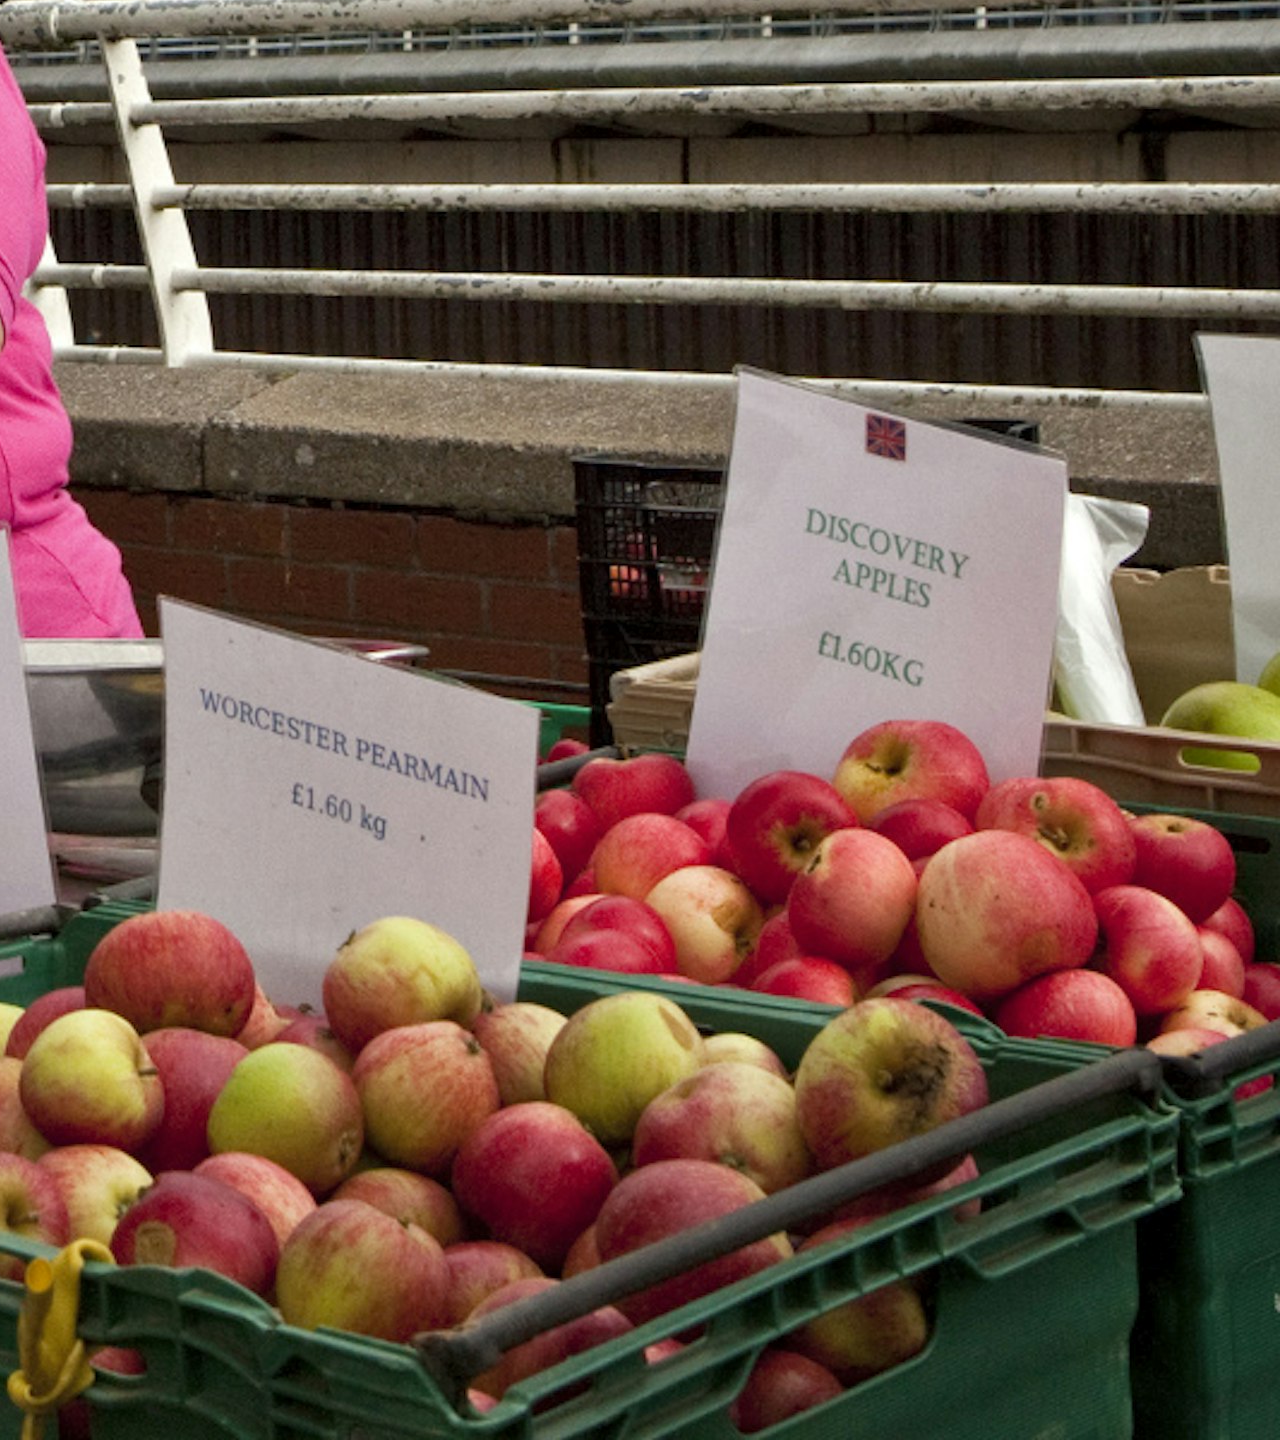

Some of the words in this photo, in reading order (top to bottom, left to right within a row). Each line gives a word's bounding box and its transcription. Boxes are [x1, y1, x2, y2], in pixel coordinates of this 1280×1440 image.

[805, 507, 970, 580] DISCOVERY
[832, 558, 933, 609] APPLES
[818, 630, 926, 688] £1.60KG
[199, 687, 349, 757] WORCESTER
[355, 736, 490, 802] PEARMAIN
[291, 781, 353, 824] £1.60
[359, 804, 388, 841] kg
